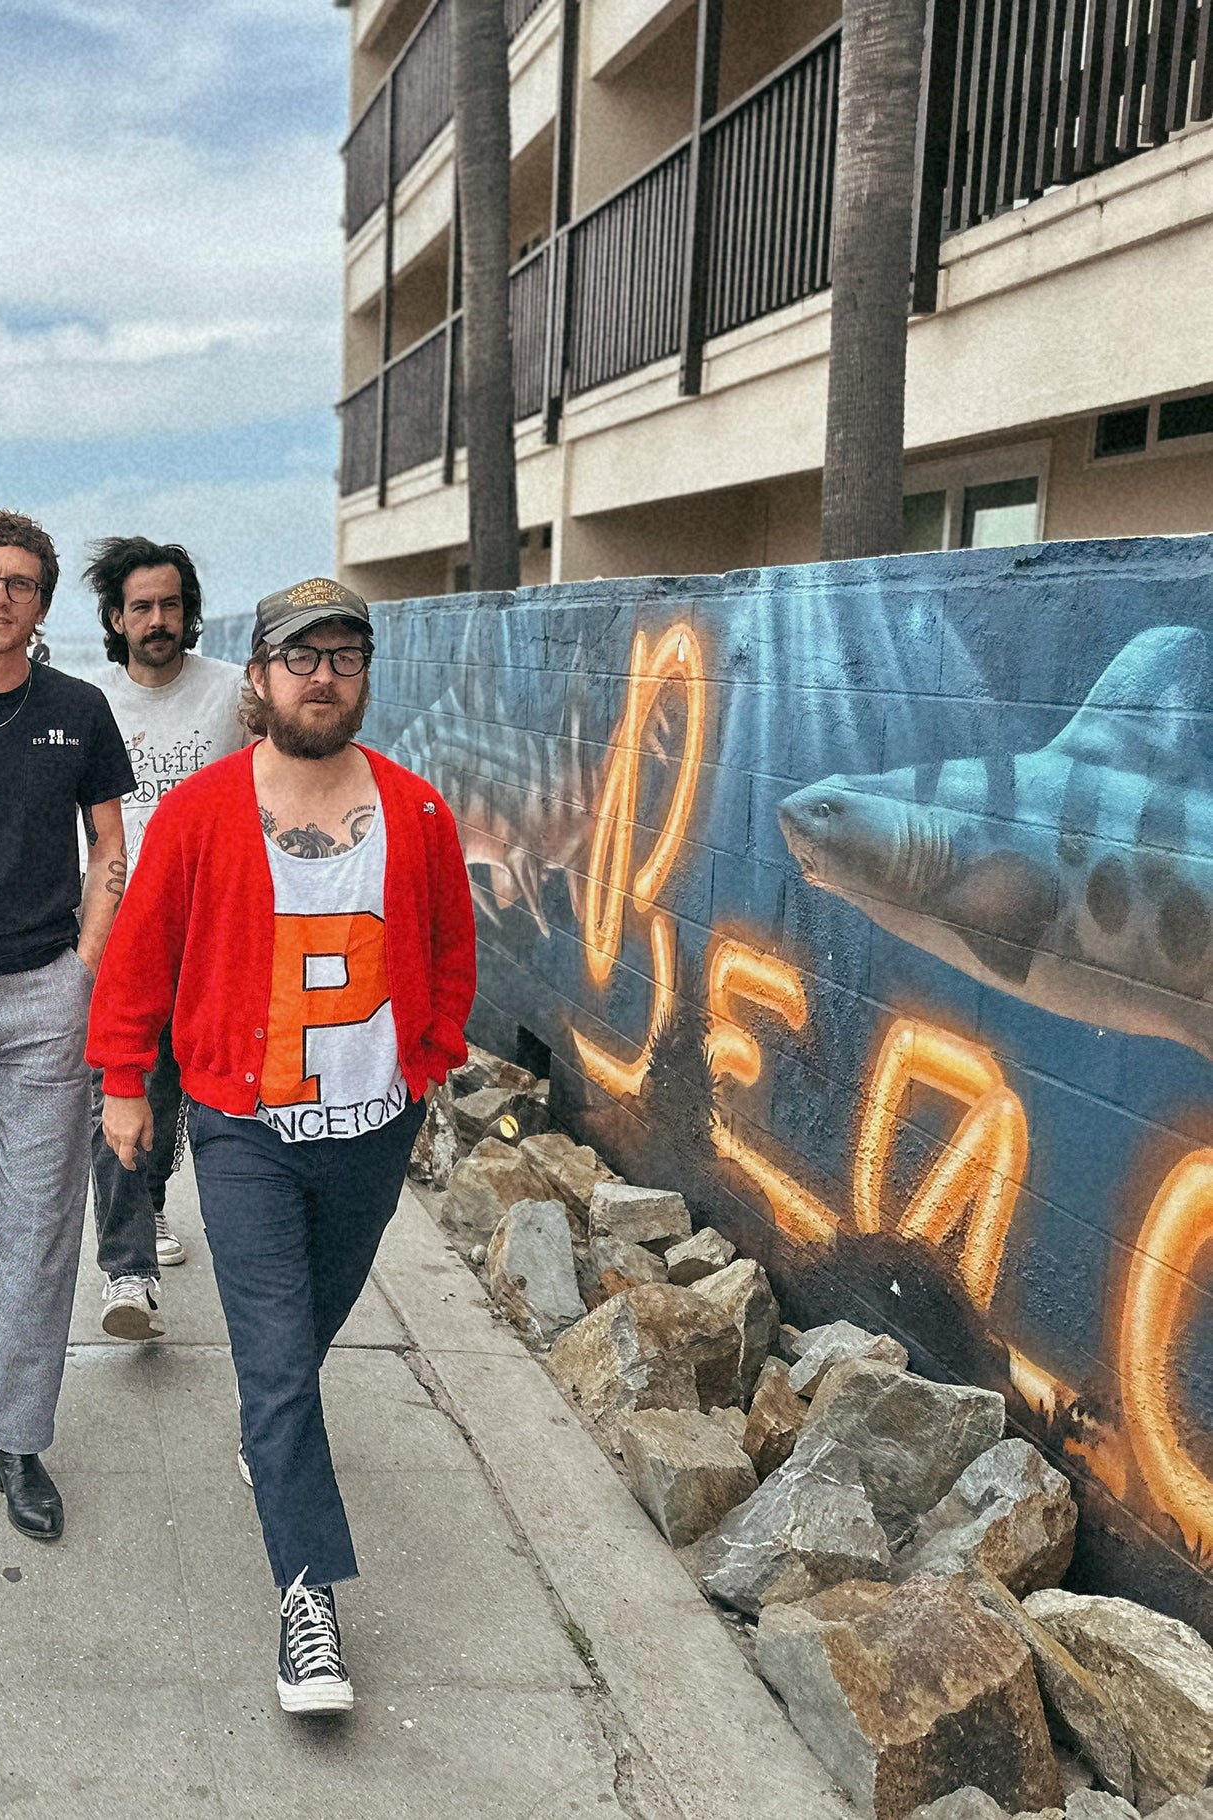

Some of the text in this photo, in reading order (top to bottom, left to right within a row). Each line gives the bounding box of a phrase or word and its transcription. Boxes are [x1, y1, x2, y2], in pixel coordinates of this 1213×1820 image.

[283, 579, 347, 604] JACKSONVILLE
[292, 592, 342, 607] MOTORCYCLES
[32, 737, 46, 745] EST
[259, 910, 392, 1108] P
